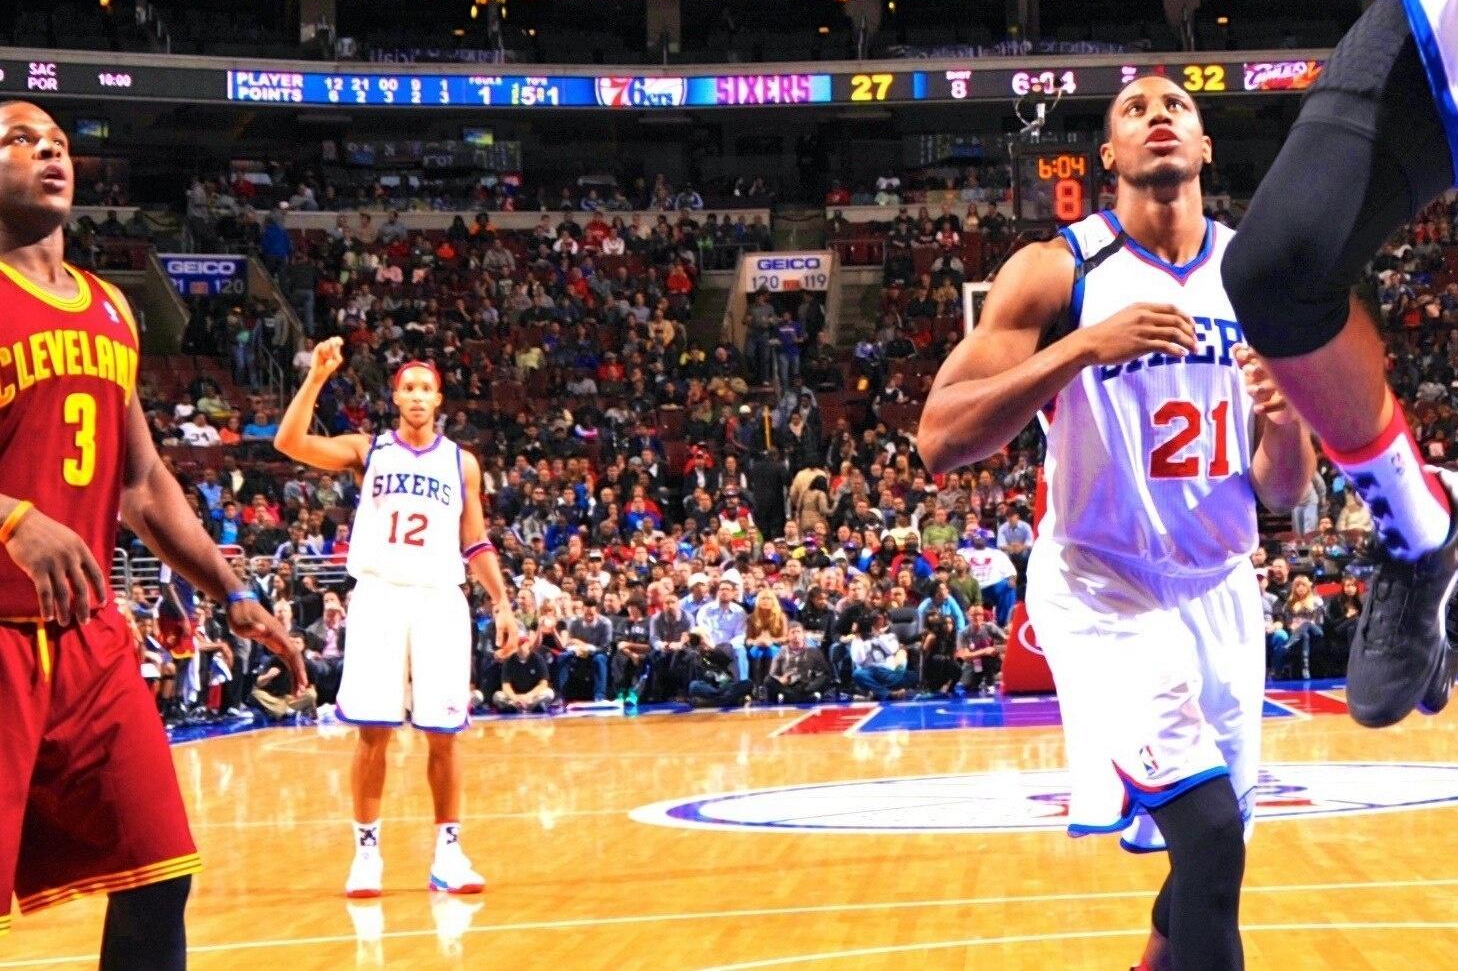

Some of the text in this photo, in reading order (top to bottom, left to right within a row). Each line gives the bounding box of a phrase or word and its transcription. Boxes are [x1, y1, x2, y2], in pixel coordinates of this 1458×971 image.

[28, 62, 57, 77] SAC
[236, 72, 304, 88] PLAYER
[1183, 65, 1226, 91] 32
[27, 77, 58, 91] POR
[236, 86, 303, 103] POINTS
[715, 75, 812, 105] SIXERS
[851, 74, 893, 101] 27
[951, 80, 967, 99] 8
[1038, 155, 1085, 179] 6:04
[1055, 180, 1082, 220] 8
[166, 260, 236, 275] GEICO
[757, 257, 820, 270] GEICO
[804, 274, 827, 289] 119
[63, 392, 97, 487] 3
[1149, 400, 1230, 478] 21
[372, 473, 452, 506] SIXERS
[388, 511, 429, 547] 12
